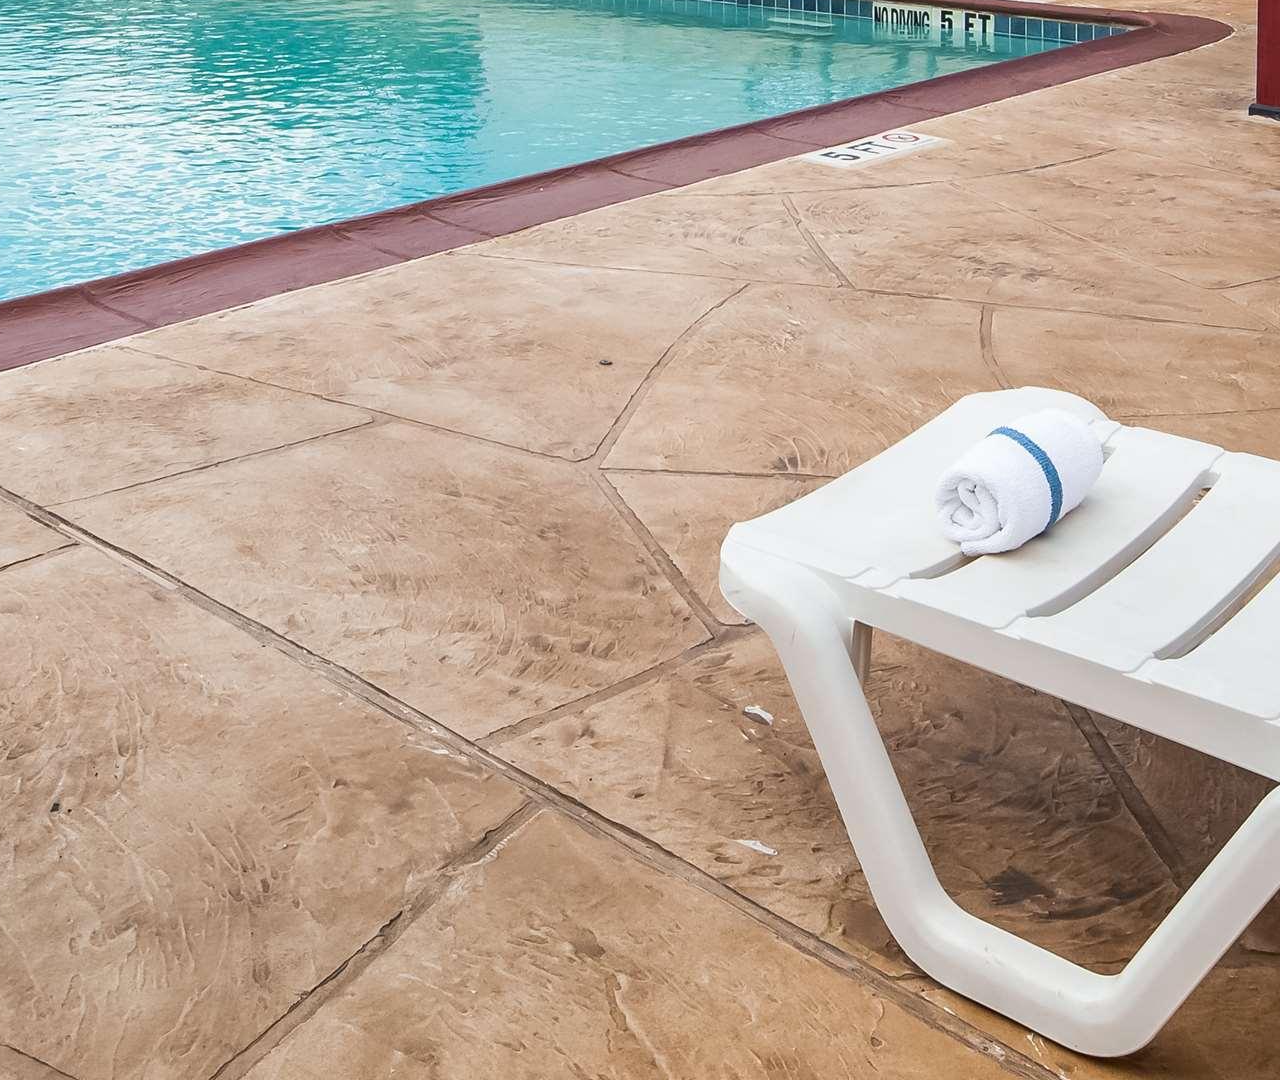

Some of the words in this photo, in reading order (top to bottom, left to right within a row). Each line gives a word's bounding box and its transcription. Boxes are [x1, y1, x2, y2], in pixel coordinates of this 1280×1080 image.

[874, 6, 888, 23] NO
[891, 7, 930, 28] DIVING
[941, 10, 953, 29] 5
[965, 13, 991, 33] FT
[820, 152, 861, 160] 5
[847, 141, 897, 154] FT
